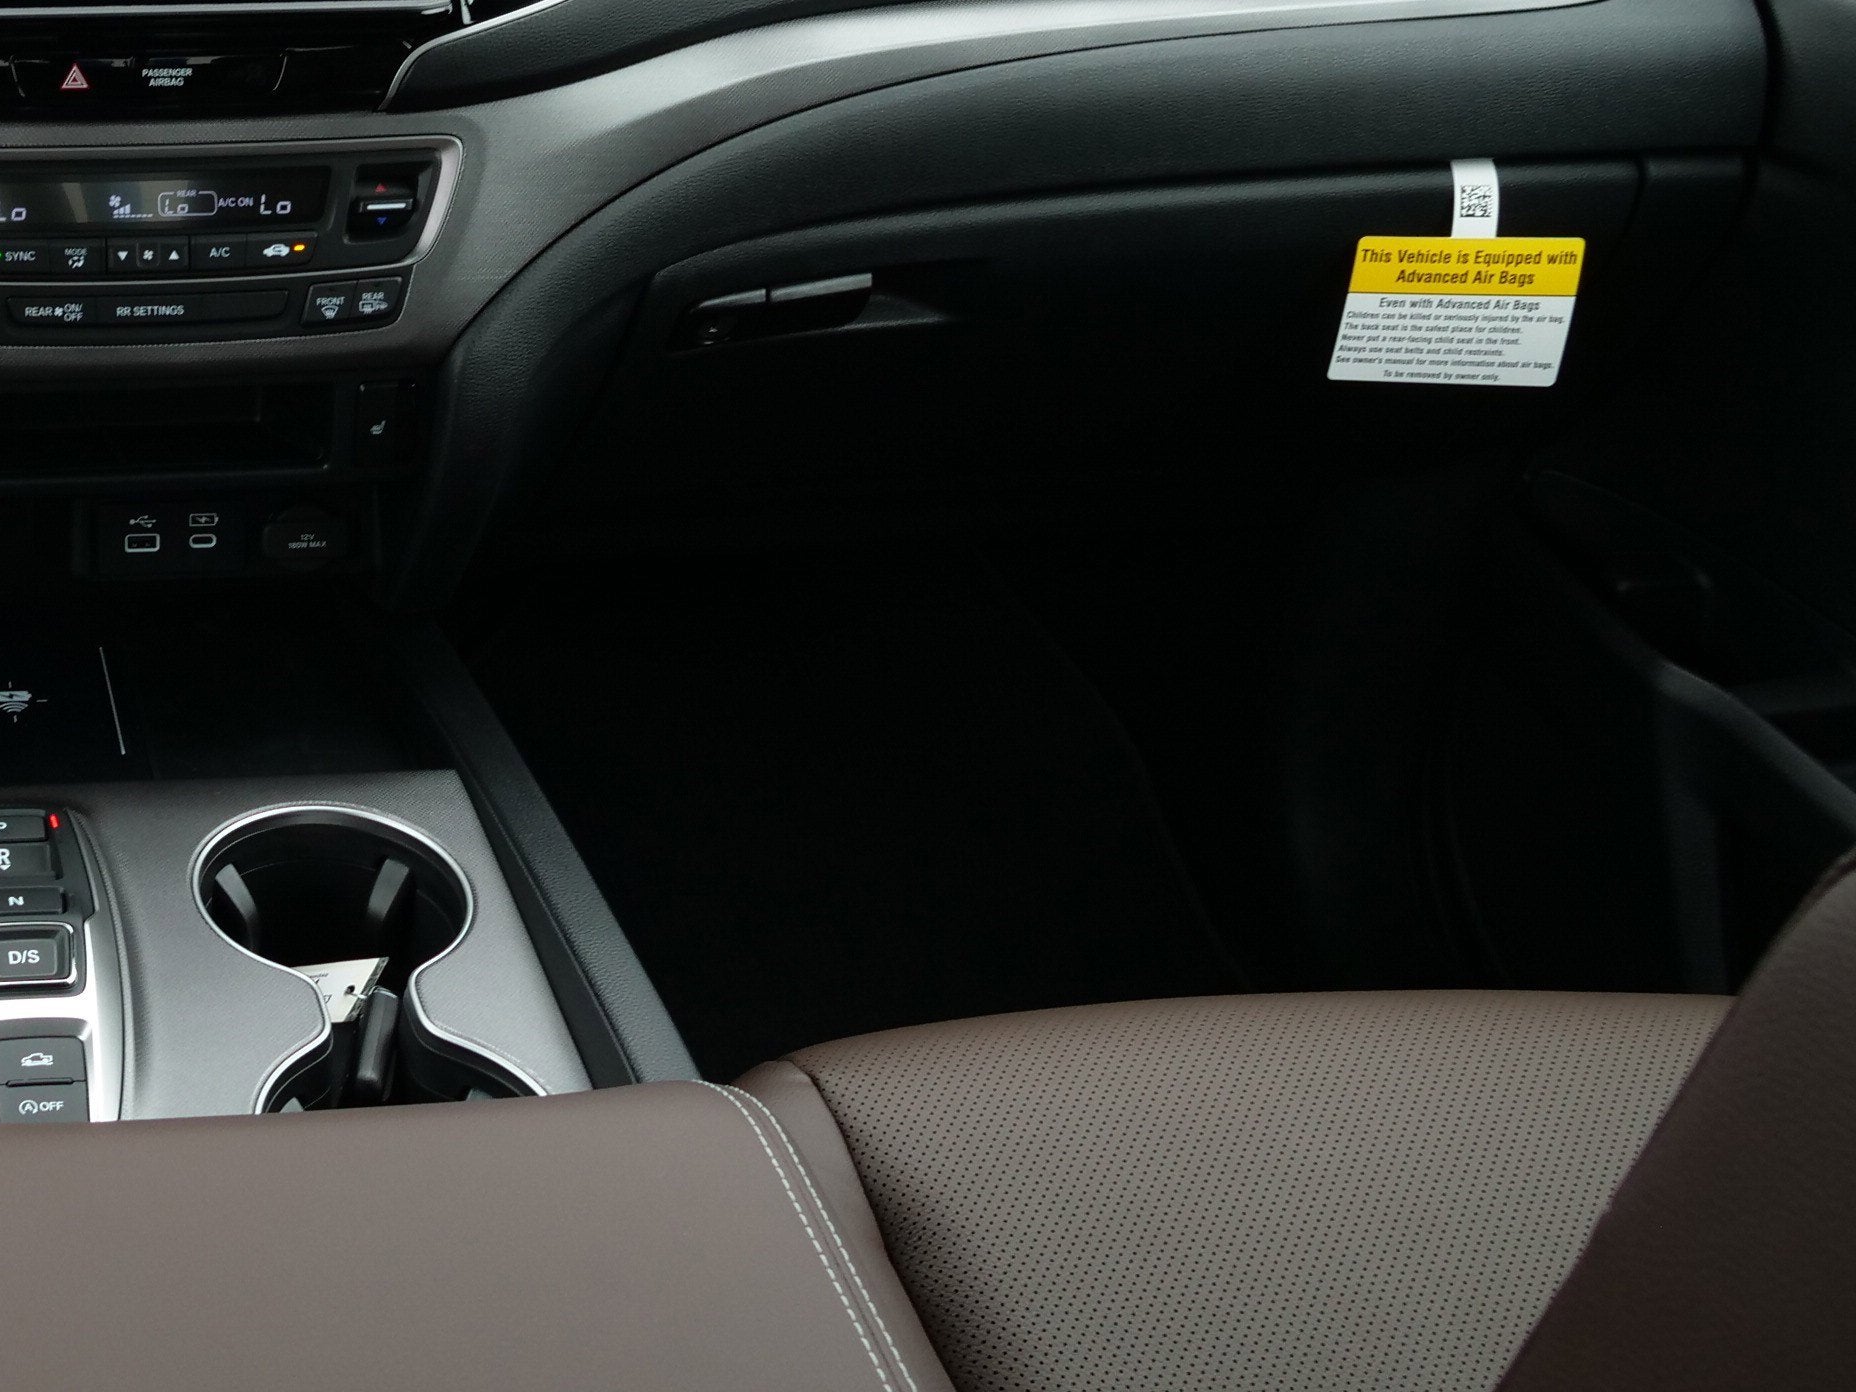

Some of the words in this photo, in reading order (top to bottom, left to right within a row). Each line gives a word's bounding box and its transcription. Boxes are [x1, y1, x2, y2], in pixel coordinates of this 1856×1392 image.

[141, 67, 193, 78] PASSENGER
[149, 77, 185, 88] AIRBAG
[217, 196, 238, 208] A/C
[238, 196, 254, 208] ON
[4, 250, 37, 263] SYNC
[64, 247, 88, 257] MODE
[209, 246, 231, 259] A/C
[1361, 248, 1392, 264] This
[1397, 249, 1452, 265] Vehicle
[1456, 249, 1469, 265] is
[1474, 249, 1542, 268] Equipped
[1546, 250, 1578, 266] with
[1395, 269, 1468, 284] Advanced
[1472, 270, 1494, 285] Air
[1497, 270, 1536, 288] Bags
[316, 296, 346, 306] FRONT
[361, 292, 385, 301] REAR
[1378, 296, 1407, 308] Even
[1409, 297, 1433, 309] with
[1435, 298, 1490, 310] Advanced
[1493, 299, 1511, 310] Air
[1513, 299, 1541, 312] Bags
[24, 305, 54, 318] REAR
[63, 312, 84, 323] OFF
[116, 305, 132, 318] RR
[133, 304, 185, 317] SETTINGS
[1346, 310, 1380, 319] Children
[1381, 312, 1396, 320] can
[1397, 311, 1408, 320] be
[1409, 312, 1432, 321] killed
[1444, 313, 1479, 323] seriously
[1510, 315, 1520, 324] by
[1521, 314, 1534, 322] the
[1536, 315, 1547, 323] air
[1344, 322, 1358, 330] The
[1360, 323, 1379, 331] back
[1381, 323, 1399, 331] seat
[1410, 324, 1423, 332] the
[1425, 324, 1450, 333] safest
[1450, 326, 1473, 335] place
[1488, 326, 1523, 334] children.
[1340, 333, 1365, 342] Never
[1366, 334, 1380, 343] put
[1434, 336, 1455, 344] child
[1456, 337, 1474, 345] seat
[1475, 337, 1483, 345] in
[1485, 337, 1498, 345] the
[1337, 344, 1367, 354] Always
[1385, 346, 1403, 354] seat
[1404, 346, 1424, 355] belts
[1425, 347, 1441, 355] and
[1442, 348, 1464, 356] child
[1335, 355, 1350, 364] See
[1351, 356, 1383, 365] owner's
[1384, 357, 1414, 365] manual
[1415, 358, 1427, 366] for
[1450, 359, 1495, 368] information
[1497, 360, 1520, 369] about
[1520, 361, 1533, 369] air
[1383, 369, 1394, 378] To
[1394, 369, 1405, 378] be
[1406, 370, 1442, 379] removed
[1443, 371, 1453, 381] by
[1455, 373, 1480, 381] owner
[8, 895, 25, 907] N
[7, 949, 41, 966] D/S
[39, 1100, 65, 1113] OFF
